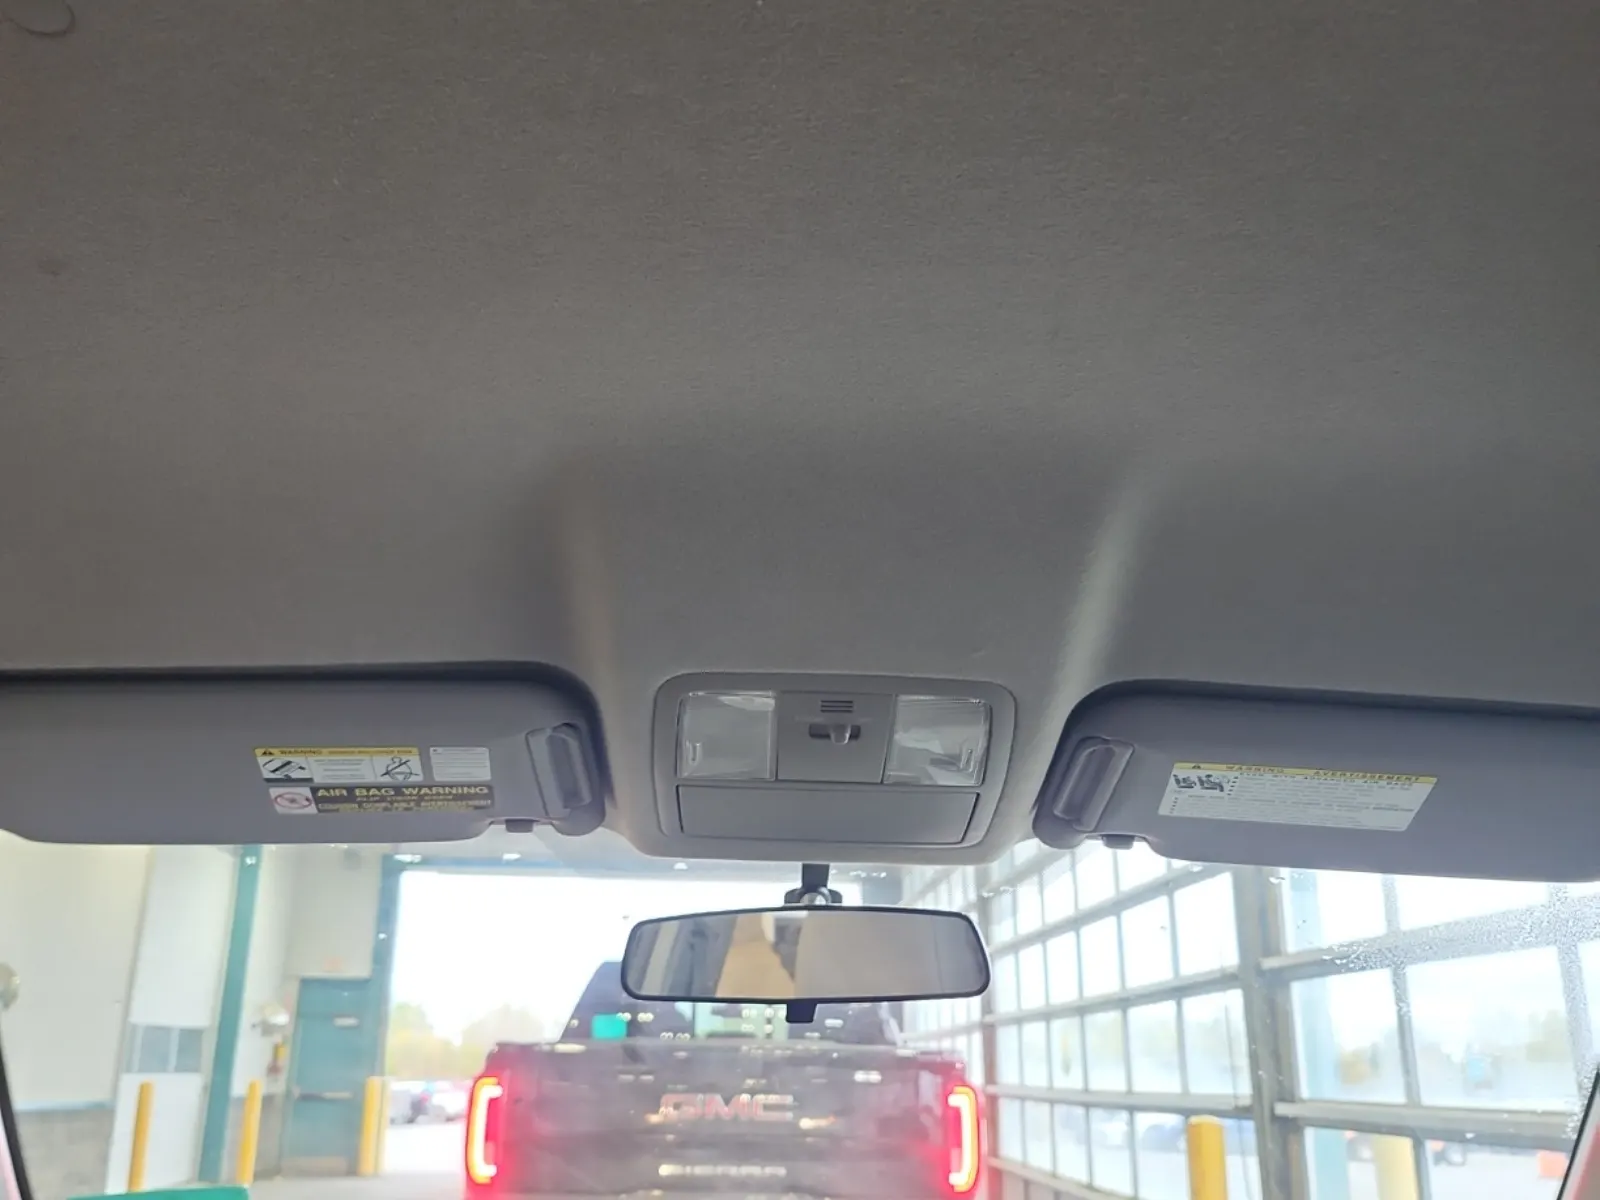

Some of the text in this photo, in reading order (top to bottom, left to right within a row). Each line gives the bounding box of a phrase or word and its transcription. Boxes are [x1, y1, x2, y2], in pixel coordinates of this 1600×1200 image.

[317, 785, 490, 797] AIR BAG WARNING
[660, 1093, 794, 1121] GMC
